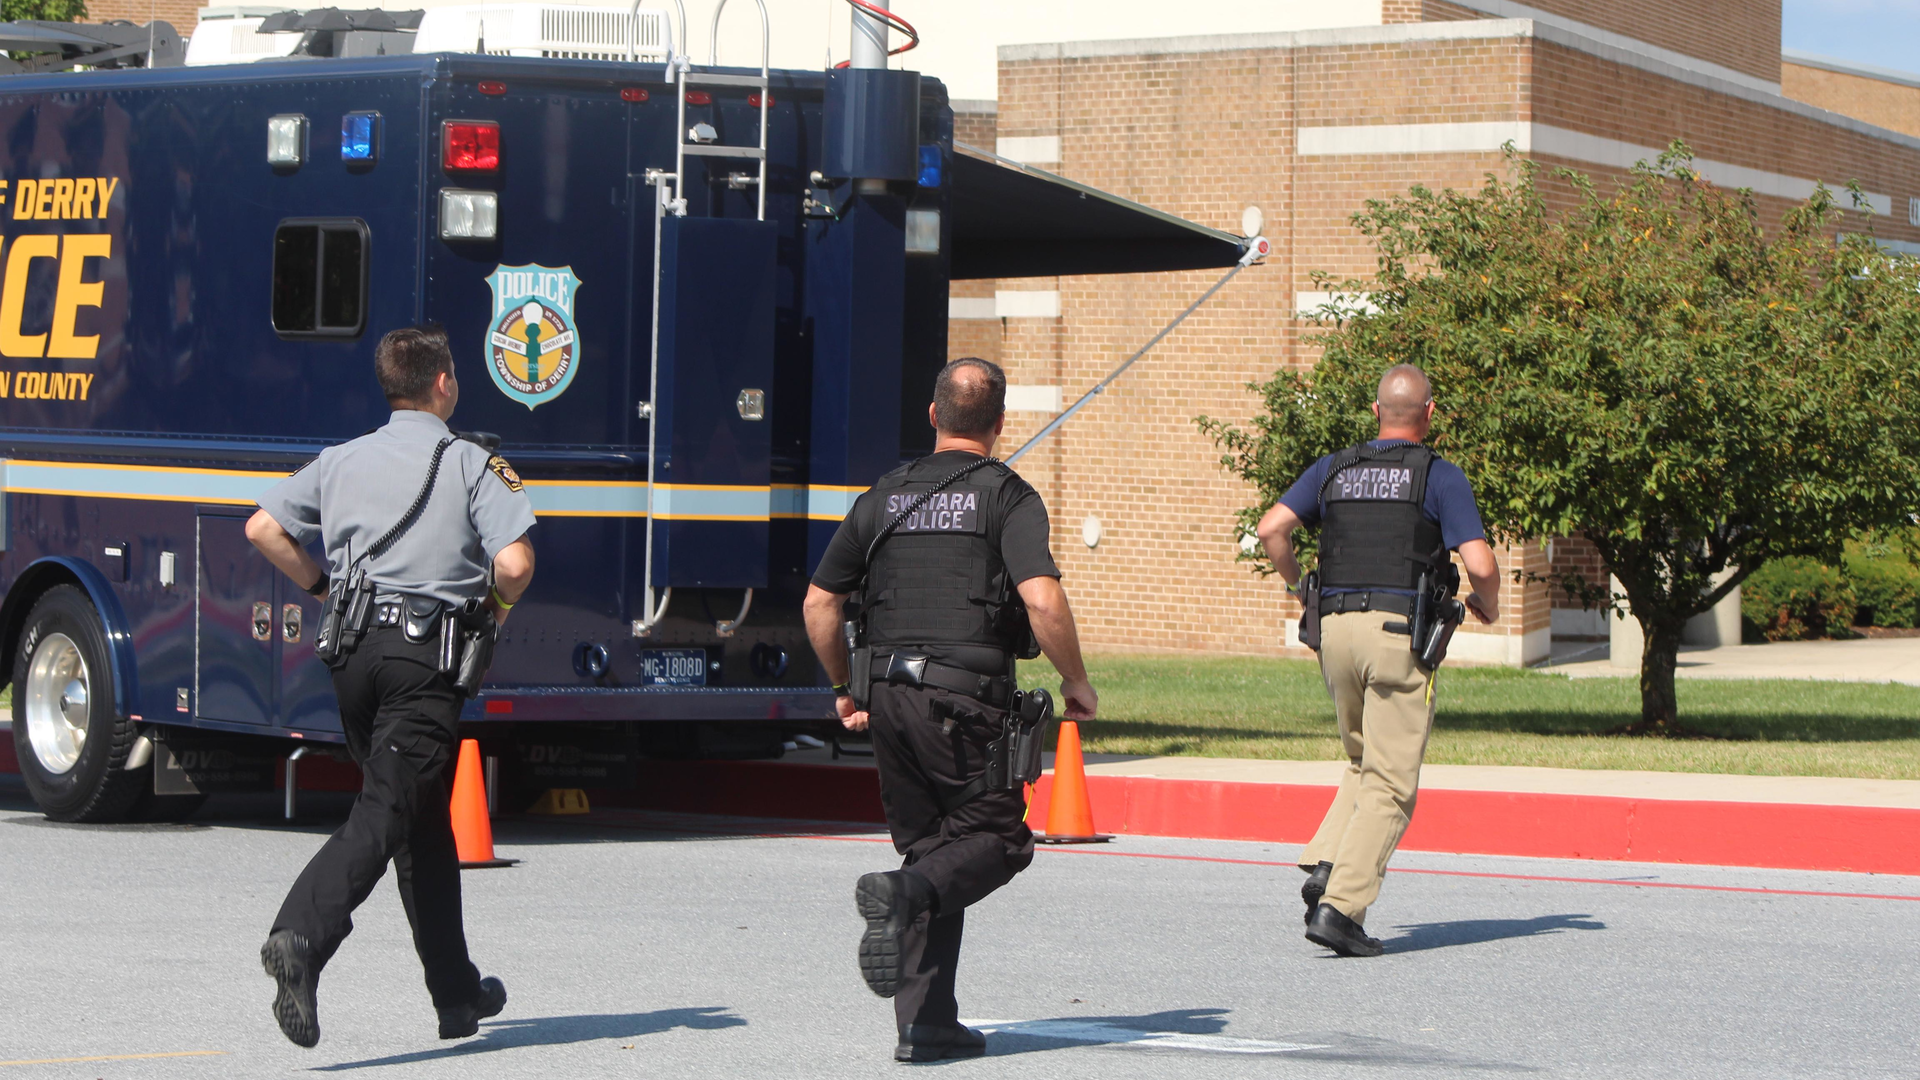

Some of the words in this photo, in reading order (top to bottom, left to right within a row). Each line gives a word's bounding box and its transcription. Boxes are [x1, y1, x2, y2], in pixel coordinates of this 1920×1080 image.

[13, 177, 119, 220] DERRY
[0, 234, 112, 359] CE
[497, 271, 570, 318] POLICE
[14, 371, 94, 401] COUNTY
[495, 352, 532, 392] TOWNSHIP
[534, 381, 548, 392] OF
[548, 352, 570, 385] DERRY
[1336, 467, 1411, 484] SWATARA
[1341, 483, 1401, 499] POLICE
[895, 511, 964, 530] OLICE
[643, 657, 703, 678] MG-1808D
